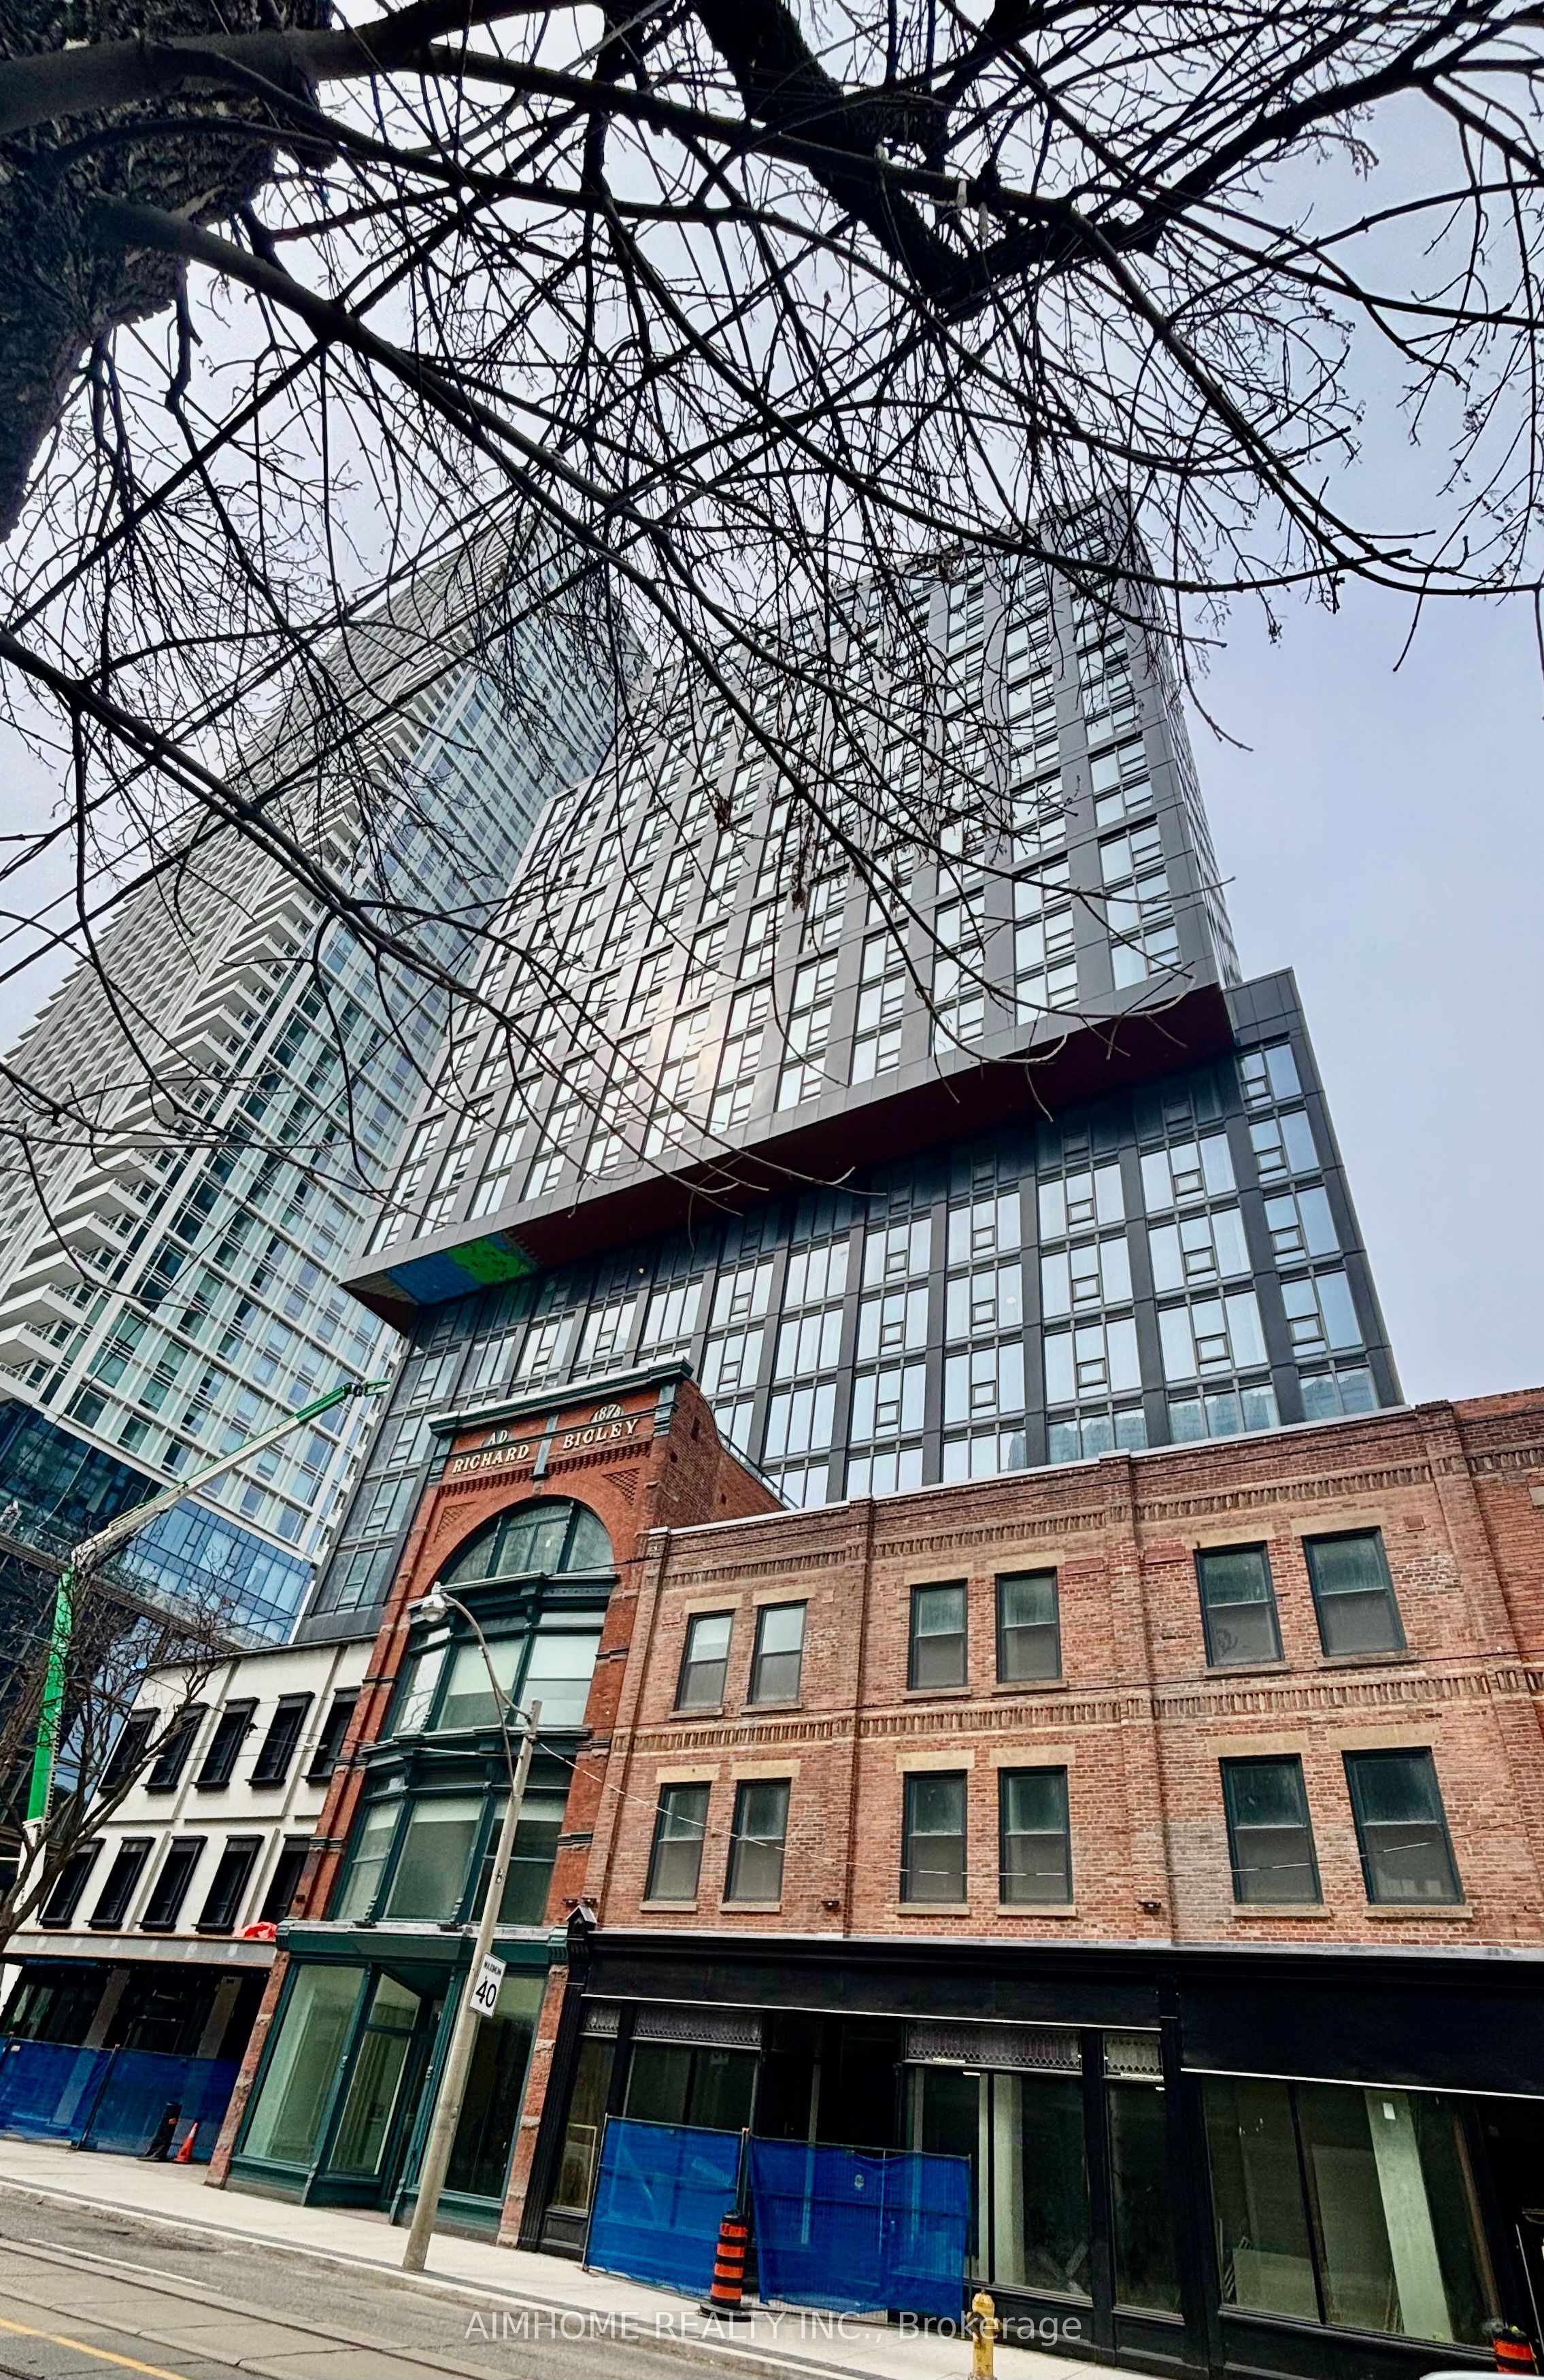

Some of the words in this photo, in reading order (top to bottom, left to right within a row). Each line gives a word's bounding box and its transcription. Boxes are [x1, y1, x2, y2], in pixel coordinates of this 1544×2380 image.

[452, 1444, 529, 1473] RICHARD
[563, 1418, 639, 1449] BIGLEY
[489, 1430, 508, 1445] AD
[475, 1979, 497, 2008] 40
